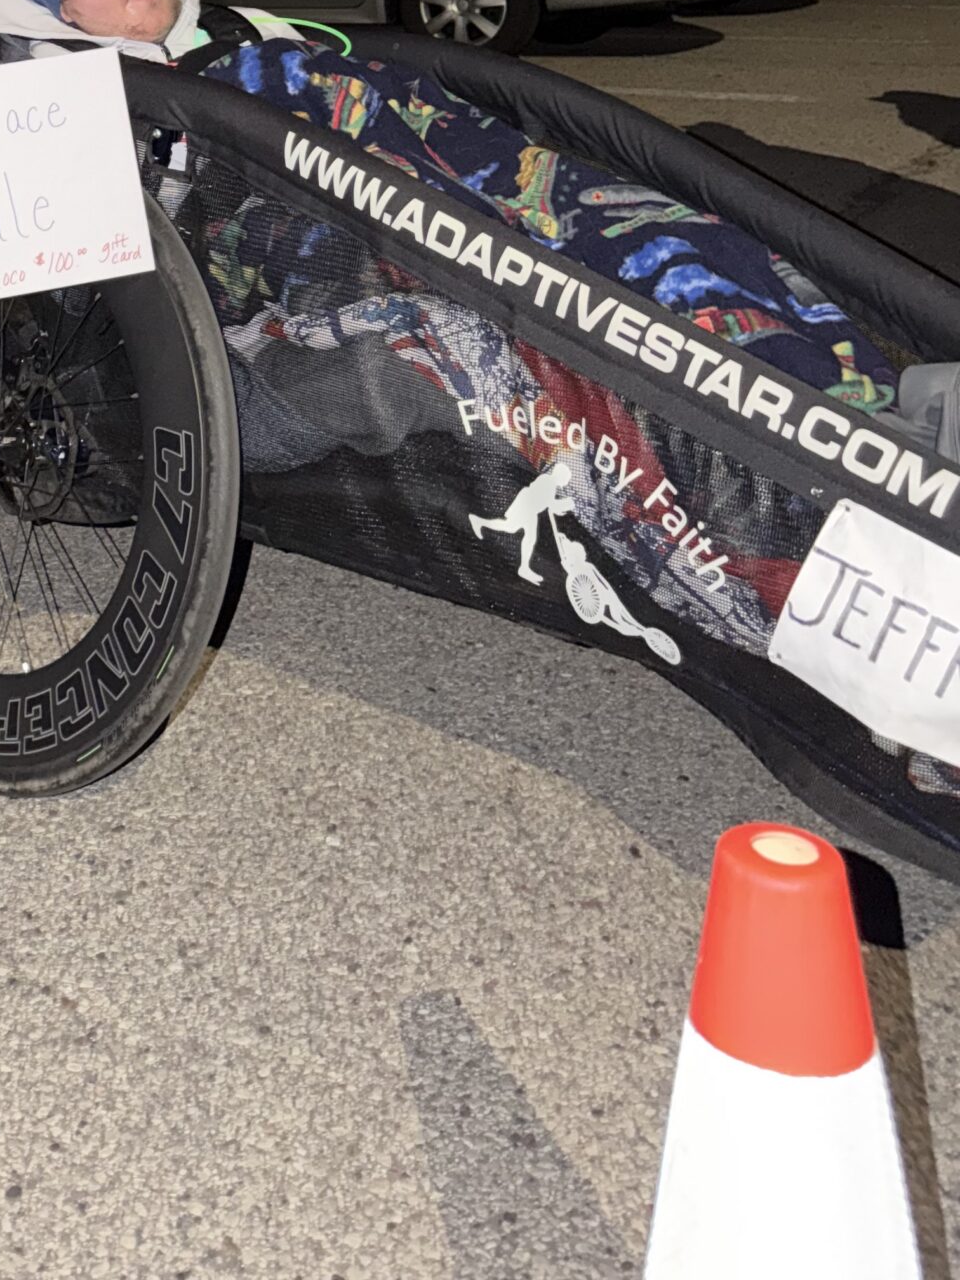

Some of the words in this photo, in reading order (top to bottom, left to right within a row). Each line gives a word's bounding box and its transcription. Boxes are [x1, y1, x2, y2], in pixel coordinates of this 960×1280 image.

[98, 233, 129, 263] gift
[111, 245, 142, 265] card
[284, 131, 960, 518] WWW.ADAPTIVESTAR.COM
[152, 426, 194, 565] C7
[456, 399, 588, 452] Fueled
[593, 434, 644, 491] By
[643, 477, 727, 594] Faith
[788, 547, 960, 699] JEFF
